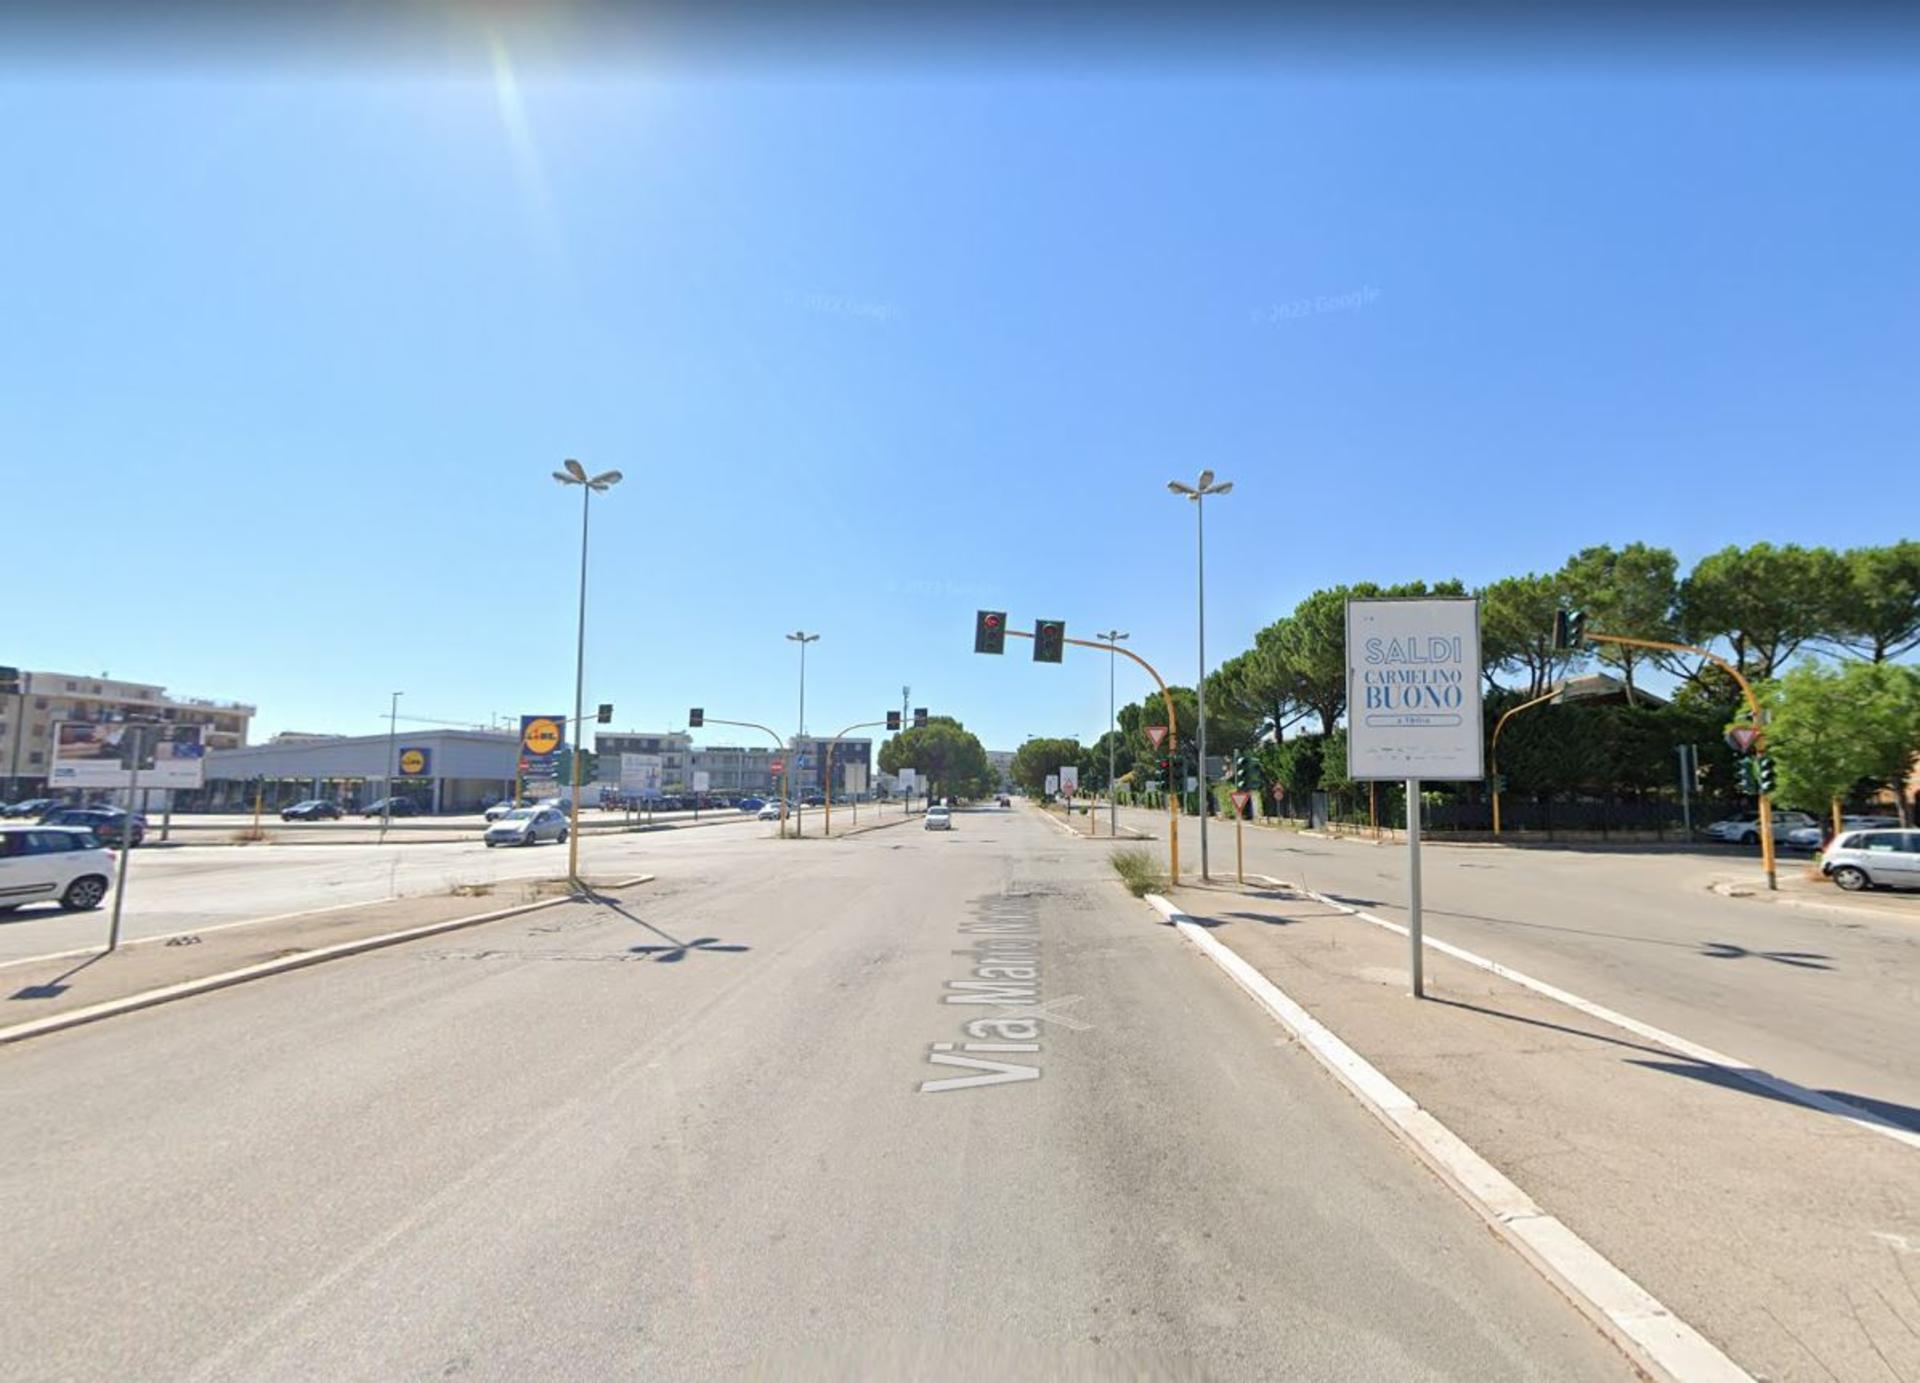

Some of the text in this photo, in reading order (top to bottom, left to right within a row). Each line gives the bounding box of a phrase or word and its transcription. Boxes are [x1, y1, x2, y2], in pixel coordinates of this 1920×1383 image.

[1365, 636, 1462, 664] SALDI
[1364, 668, 1462, 685] CARMELINO
[1366, 685, 1462, 709] BUONO
